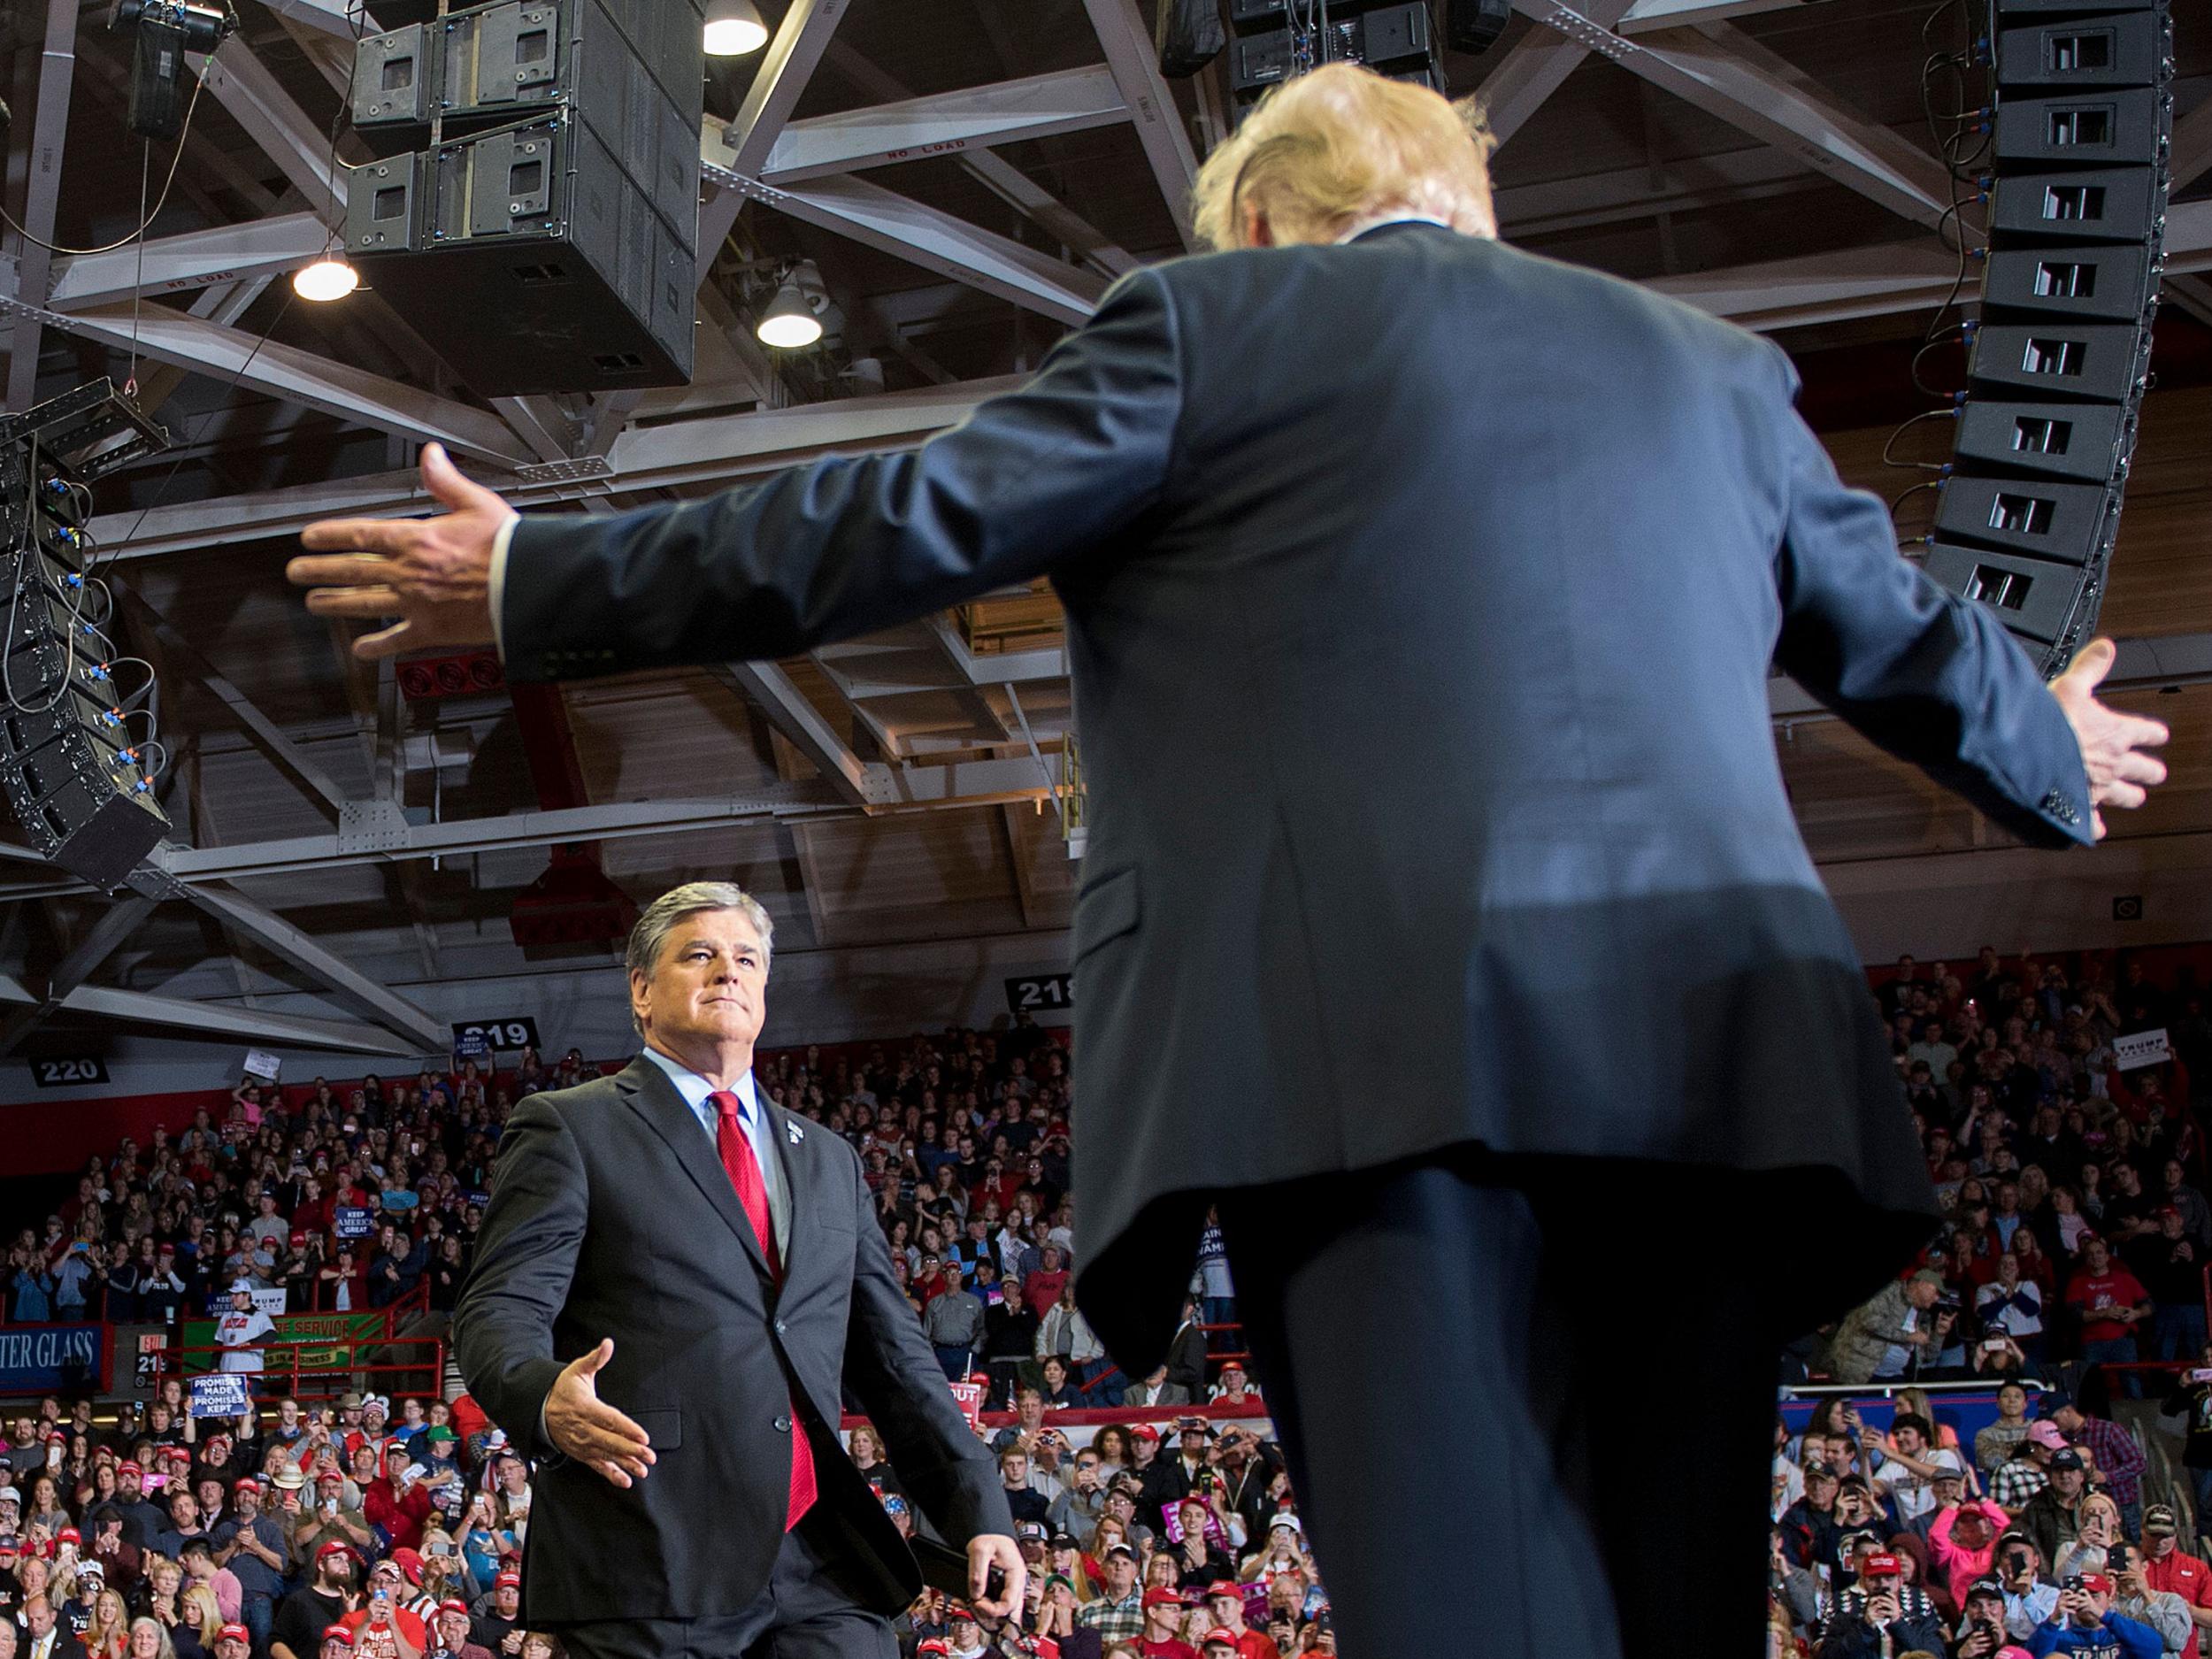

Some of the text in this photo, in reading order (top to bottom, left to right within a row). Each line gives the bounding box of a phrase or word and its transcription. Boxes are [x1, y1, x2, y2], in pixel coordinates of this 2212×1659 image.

[887, 140, 965, 159] NO LOAD
[166, 272, 234, 289] NO LOAD
[40, 1057, 98, 1082] 220
[216, 1295, 232, 1304] KEE
[295, 1317, 349, 1340] SERVICE
[36, 1331, 93, 1369] GLASS
[143, 1336, 161, 1351] EXIT
[195, 1377, 242, 1388] PROMISES
[204, 1386, 233, 1395] MADE
[195, 1396, 245, 1406] PROMISES
[206, 1404, 233, 1414] KEPT
